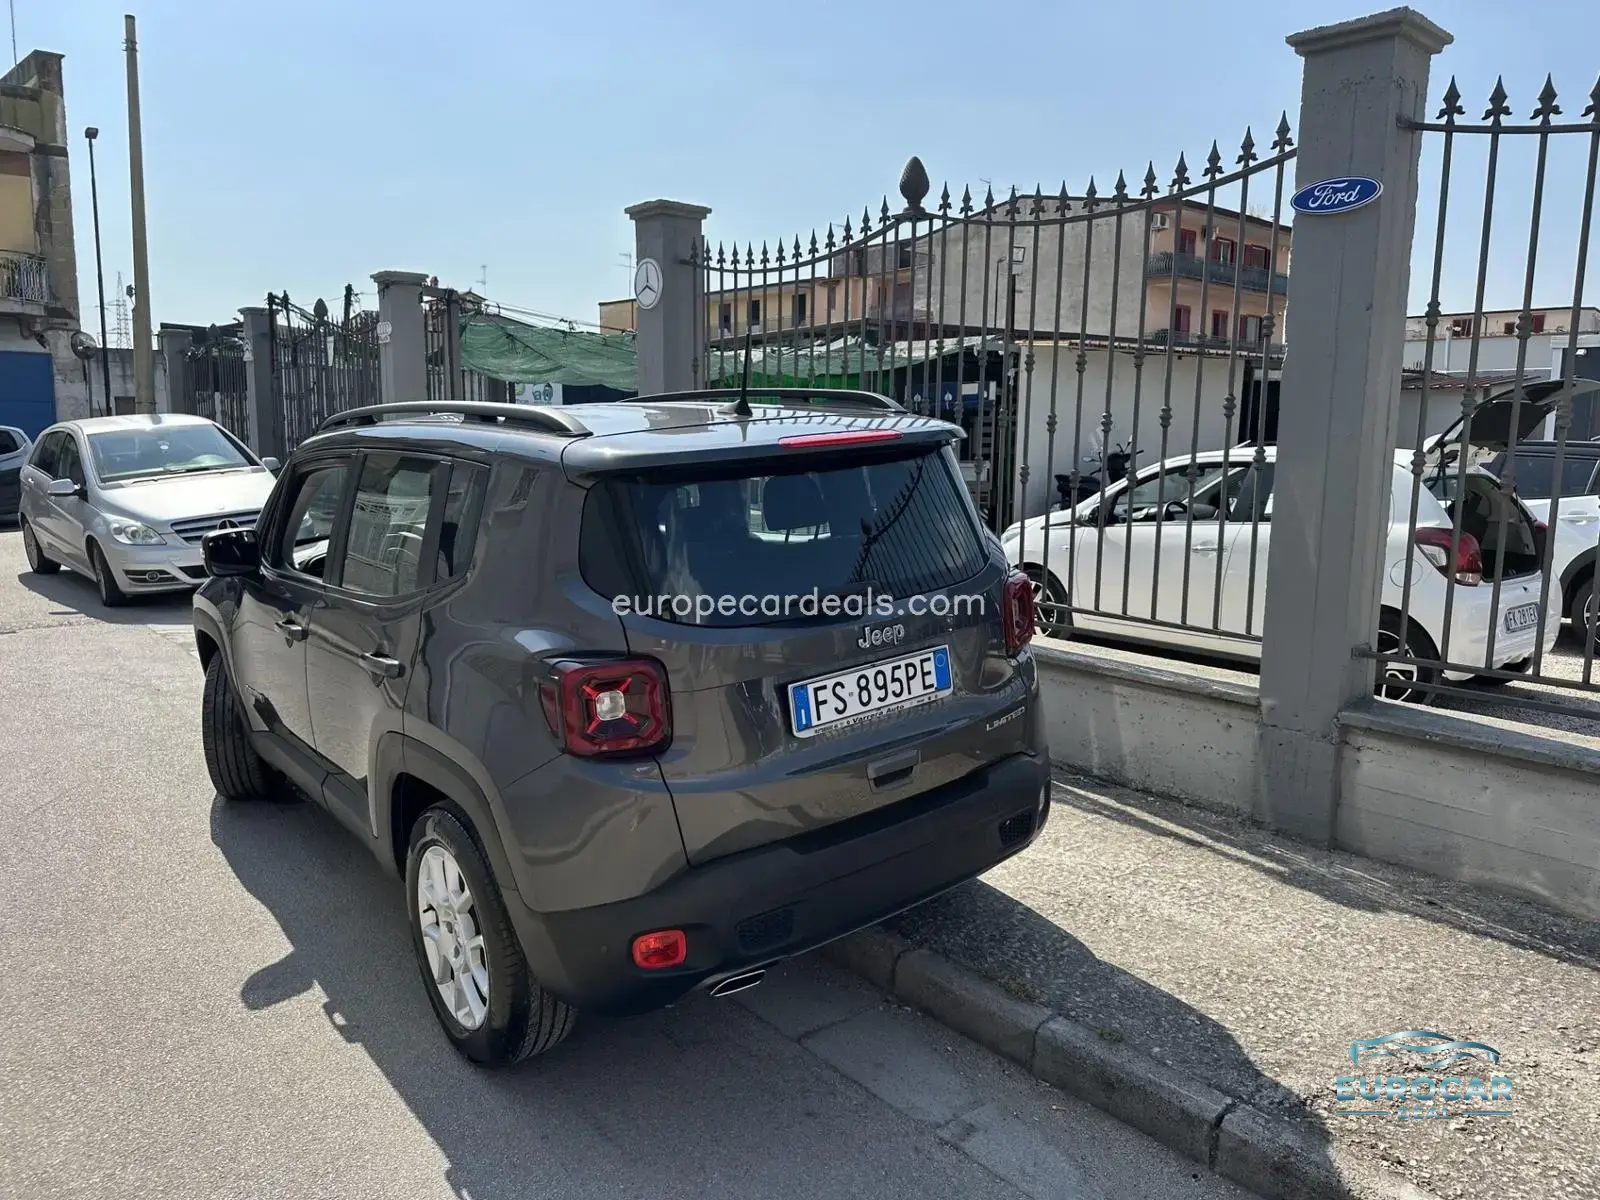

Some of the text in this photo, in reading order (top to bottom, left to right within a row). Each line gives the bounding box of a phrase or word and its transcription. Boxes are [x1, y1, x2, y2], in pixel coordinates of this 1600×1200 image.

[1308, 182, 1361, 207] Ford
[858, 624, 904, 648] Jeep
[813, 681, 847, 721] FS
[857, 657, 935, 707] 895PE
